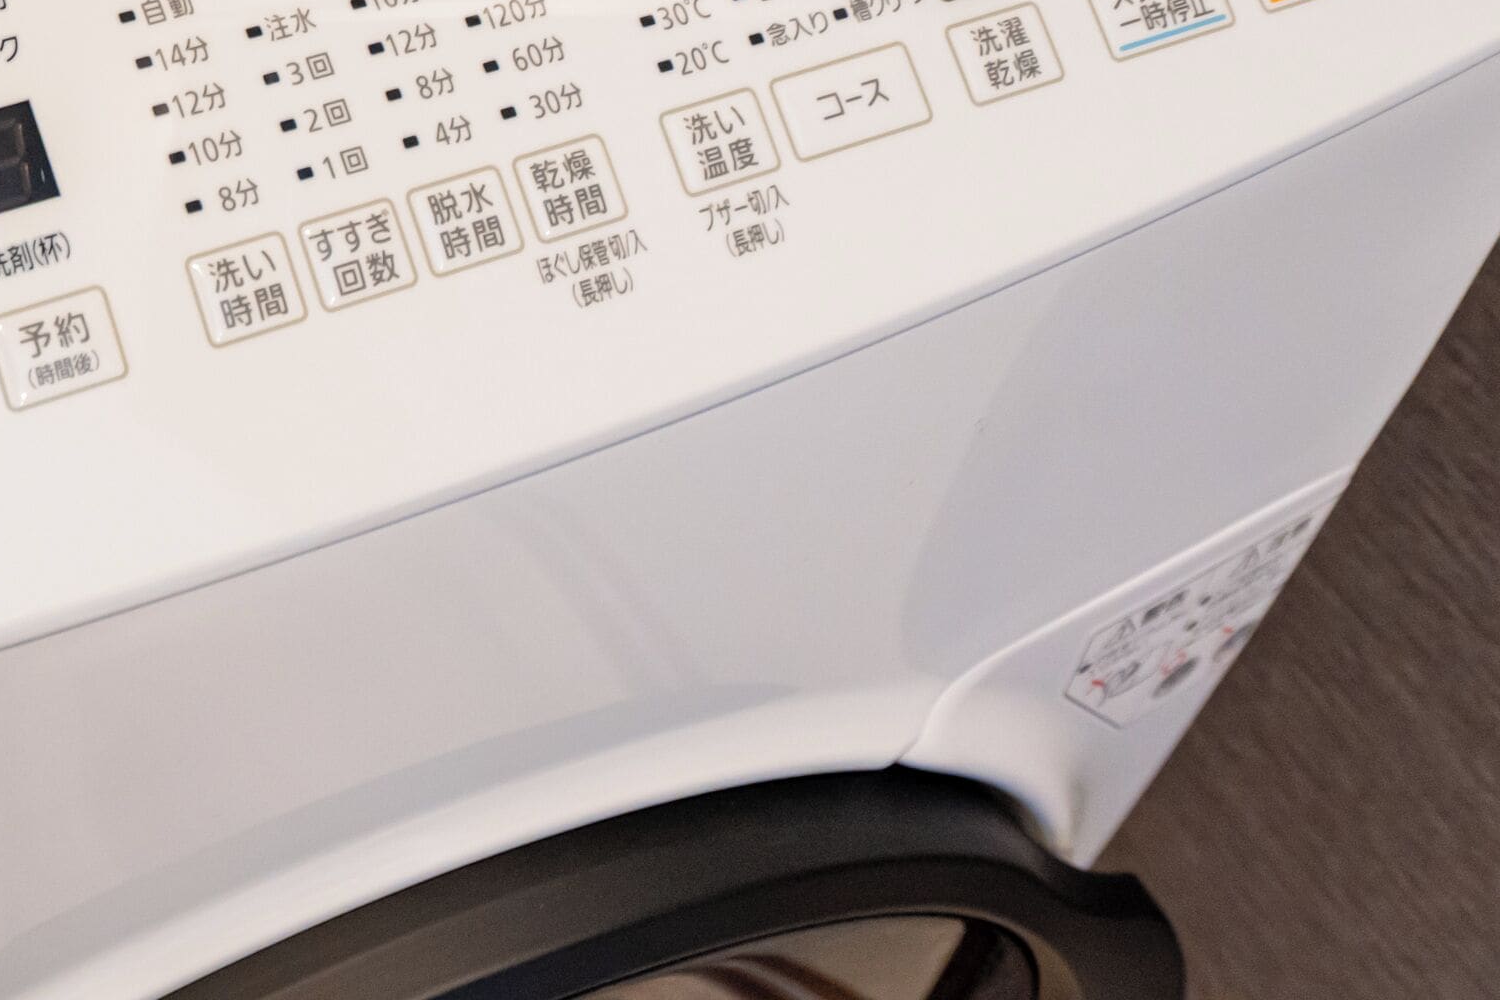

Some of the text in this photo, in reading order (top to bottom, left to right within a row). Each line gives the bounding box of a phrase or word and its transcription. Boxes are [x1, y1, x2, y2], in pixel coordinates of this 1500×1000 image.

[265, 7, 318, 43] 注水
[385, 23, 439, 57] 12分
[766, 10, 830, 48] 念入り
[970, 16, 1031, 57] 洗濯
[155, 36, 210, 71] 14分
[289, 51, 336, 86] 3回
[511, 35, 566, 72] 60分
[675, 40, 731, 76] 20℃
[983, 49, 1043, 90] 乾燥
[171, 82, 228, 119] 12分
[416, 68, 456, 102] 8分
[529, 82, 584, 120] 30分
[816, 78, 889, 122] コース
[304, 98, 353, 133] 2回
[435, 114, 473, 148] 4分
[683, 106, 746, 146] 洗い
[188, 130, 244, 167] 10分
[321, 145, 369, 179] 1回
[697, 136, 759, 180] 温度
[530, 148, 597, 193] 乾燥
[219, 177, 261, 213] 8分
[427, 182, 495, 226] 脱水
[543, 183, 609, 228] 時間
[699, 184, 790, 232] ブザー切/入
[308, 213, 393, 262] すすぎ
[440, 215, 506, 260] 時間
[536, 228, 648, 284] ほぐし保管切/入
[725, 218, 786, 258] (長押し)
[208, 249, 278, 294] 洗い
[333, 250, 400, 297] 回数
[571, 272, 635, 309] (長押し)
[220, 283, 289, 329] 時間
[19, 312, 91, 358] 予約
[26, 350, 101, 389] (時間後)
